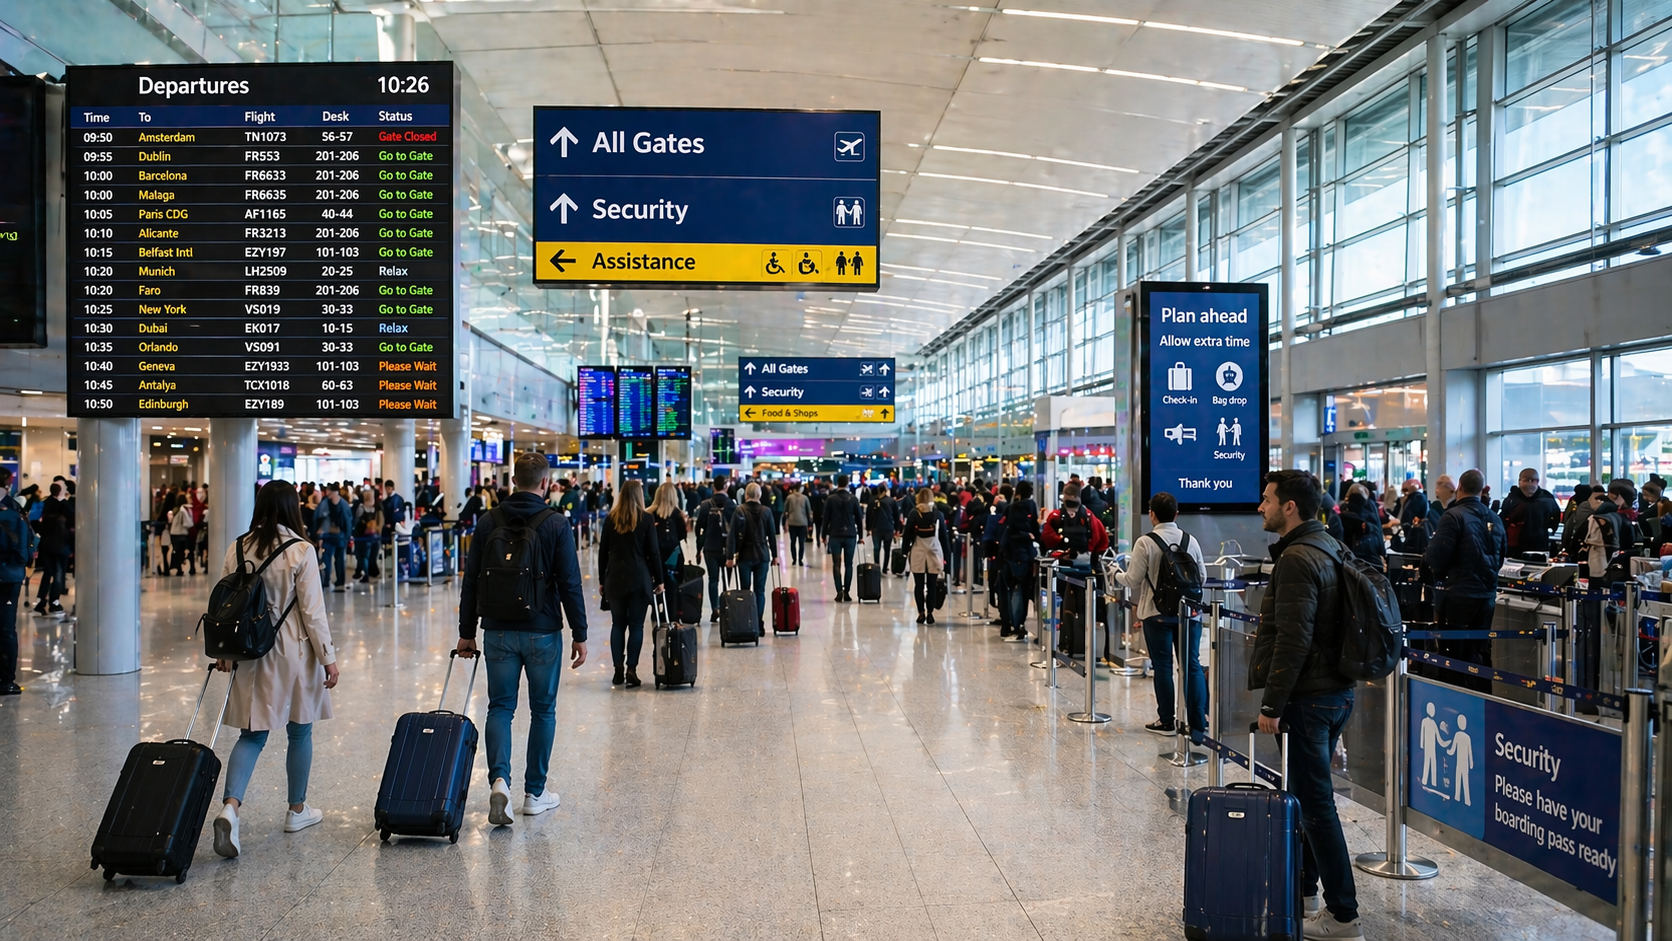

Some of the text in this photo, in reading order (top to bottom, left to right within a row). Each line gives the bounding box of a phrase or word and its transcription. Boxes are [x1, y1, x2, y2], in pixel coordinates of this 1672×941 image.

[139, 76, 429, 99] Departures 10:26
[84, 110, 413, 124] Time To Flight Desk Status
[83, 131, 437, 142] 09:50 Amsterdam TN1073 56-57 Gate Closed
[592, 131, 704, 154] All Gates
[84, 151, 433, 162] 09:55 Dublin FR553 201-206 Go to Gate
[84, 170, 433, 181] 10:00 Barcelona FR6633 201-206 Go to Gate
[84, 189, 433, 202] 10:00 Malaga FR6635 201-206 Go to Gate
[84, 209, 433, 219] 10:05 Paris CDG AF1165 40-44 Go to Gate
[593, 199, 689, 225] Security
[84, 228, 433, 238] 10:10 Alicante FR3213 201-206 Go to Gate
[84, 247, 433, 257] 10:15 Belfast Intl EZY197 101-103 Go to Gate
[592, 252, 695, 270] Assistance
[84, 265, 408, 276] 10:20 Munich LH2509 20-25 Relax
[84, 285, 433, 295] 10:20 Faro FR839 201-206 Go to Gate
[84, 304, 433, 314] 10:25 New York VS019 30-33 Go to Gate
[1162, 307, 1247, 323] Plan ahead
[84, 322, 408, 333] 10:30 Dubai EK017 10-15 Relax
[1159, 335, 1250, 347] Allow extra time
[85, 342, 433, 352] 10:35 Orlando VS091 30-33 Go to Gate
[84, 361, 437, 371] 10:40 Geneva EZY1933 101-103 Please Wait
[761, 363, 808, 374] All Gates
[84, 380, 437, 392] 10:45 Antalya TCX1018 60-63 Please Wait
[762, 386, 804, 399] Security
[84, 399, 437, 411] 10:50 Edinburgh EZY189 101-103 Please Wait
[1162, 395, 1197, 404] Check-in
[1212, 396, 1247, 407] Bag drop
[762, 409, 783, 417] Food
[785, 409, 791, 417] &
[1214, 450, 1245, 461] Security
[1178, 477, 1232, 491] Thank you
[1494, 731, 1561, 782] Security
[1495, 774, 1602, 835] Please have your
[1494, 803, 1616, 878] boarding pass ready
